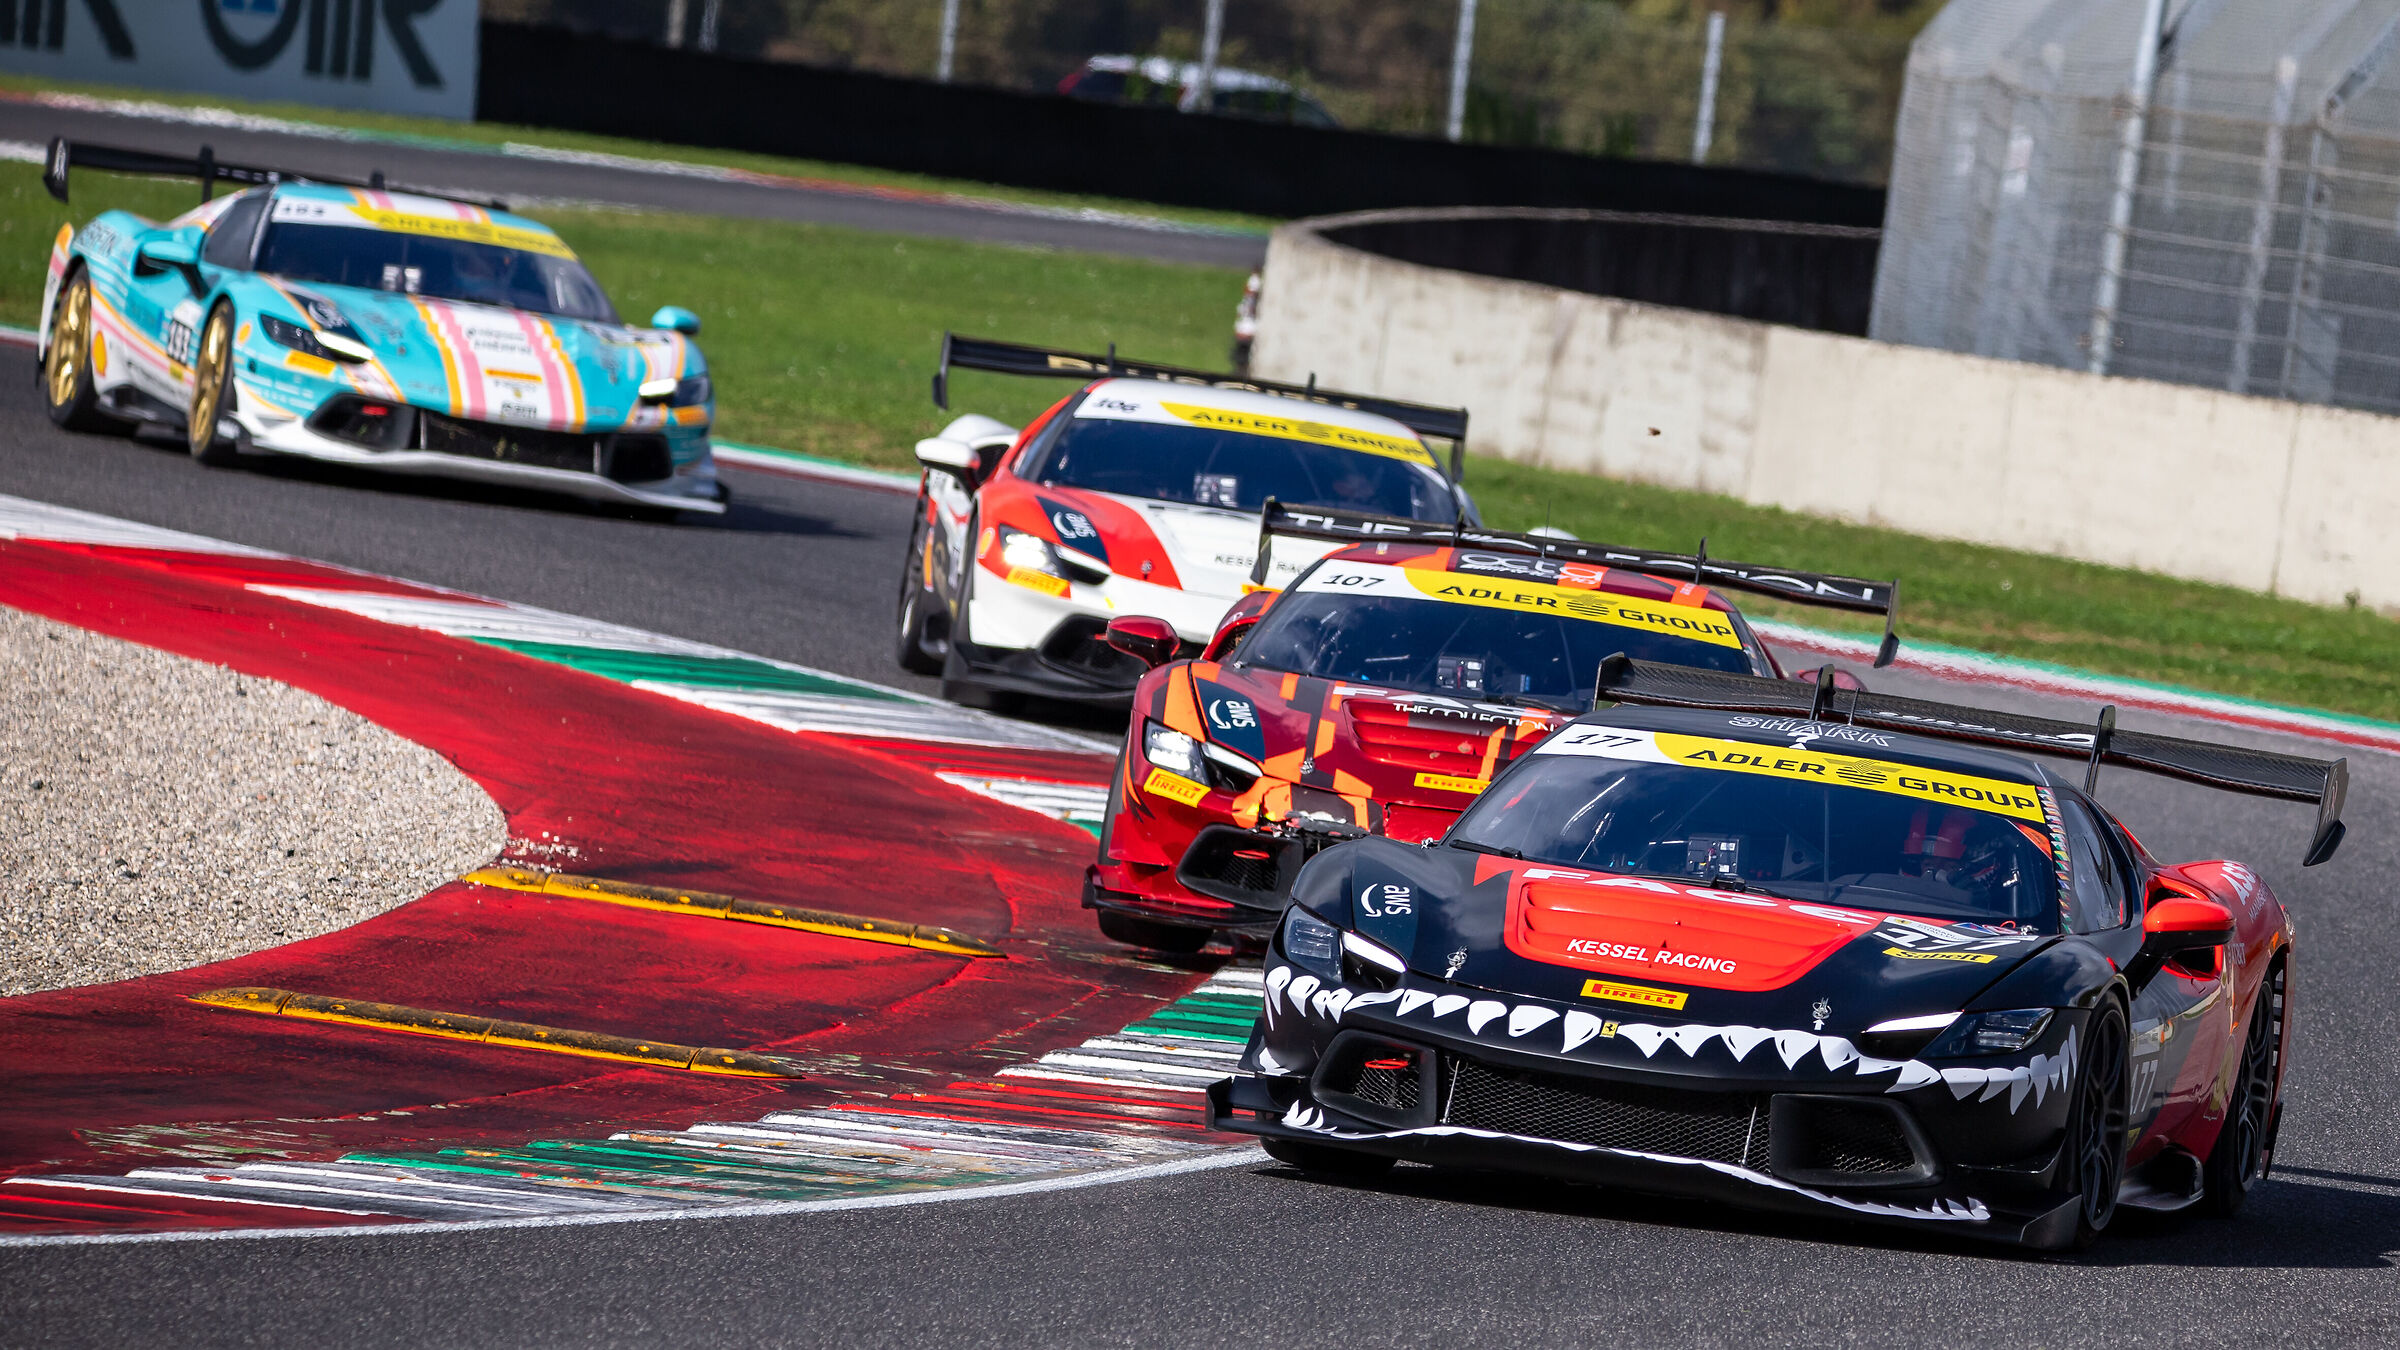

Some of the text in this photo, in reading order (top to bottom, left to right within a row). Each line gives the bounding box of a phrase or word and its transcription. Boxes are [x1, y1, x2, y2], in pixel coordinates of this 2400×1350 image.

[1193, 411, 1289, 432] ADLER
[1323, 574, 1386, 588] 107
[1437, 585, 1732, 637] ADLER GROUP
[1226, 700, 1256, 728] aws
[1564, 733, 1643, 748] 177
[1728, 714, 1896, 748] SHARK
[1150, 773, 1201, 800] PIRELLI
[1685, 750, 2036, 810] ADLER GROUP
[1383, 884, 1412, 915] aws
[1873, 928, 2021, 951] 177
[1566, 938, 1737, 974] KESSEL RACING
[1897, 950, 1984, 962] Sabelt
[1591, 983, 1678, 1005] PIRELLI
